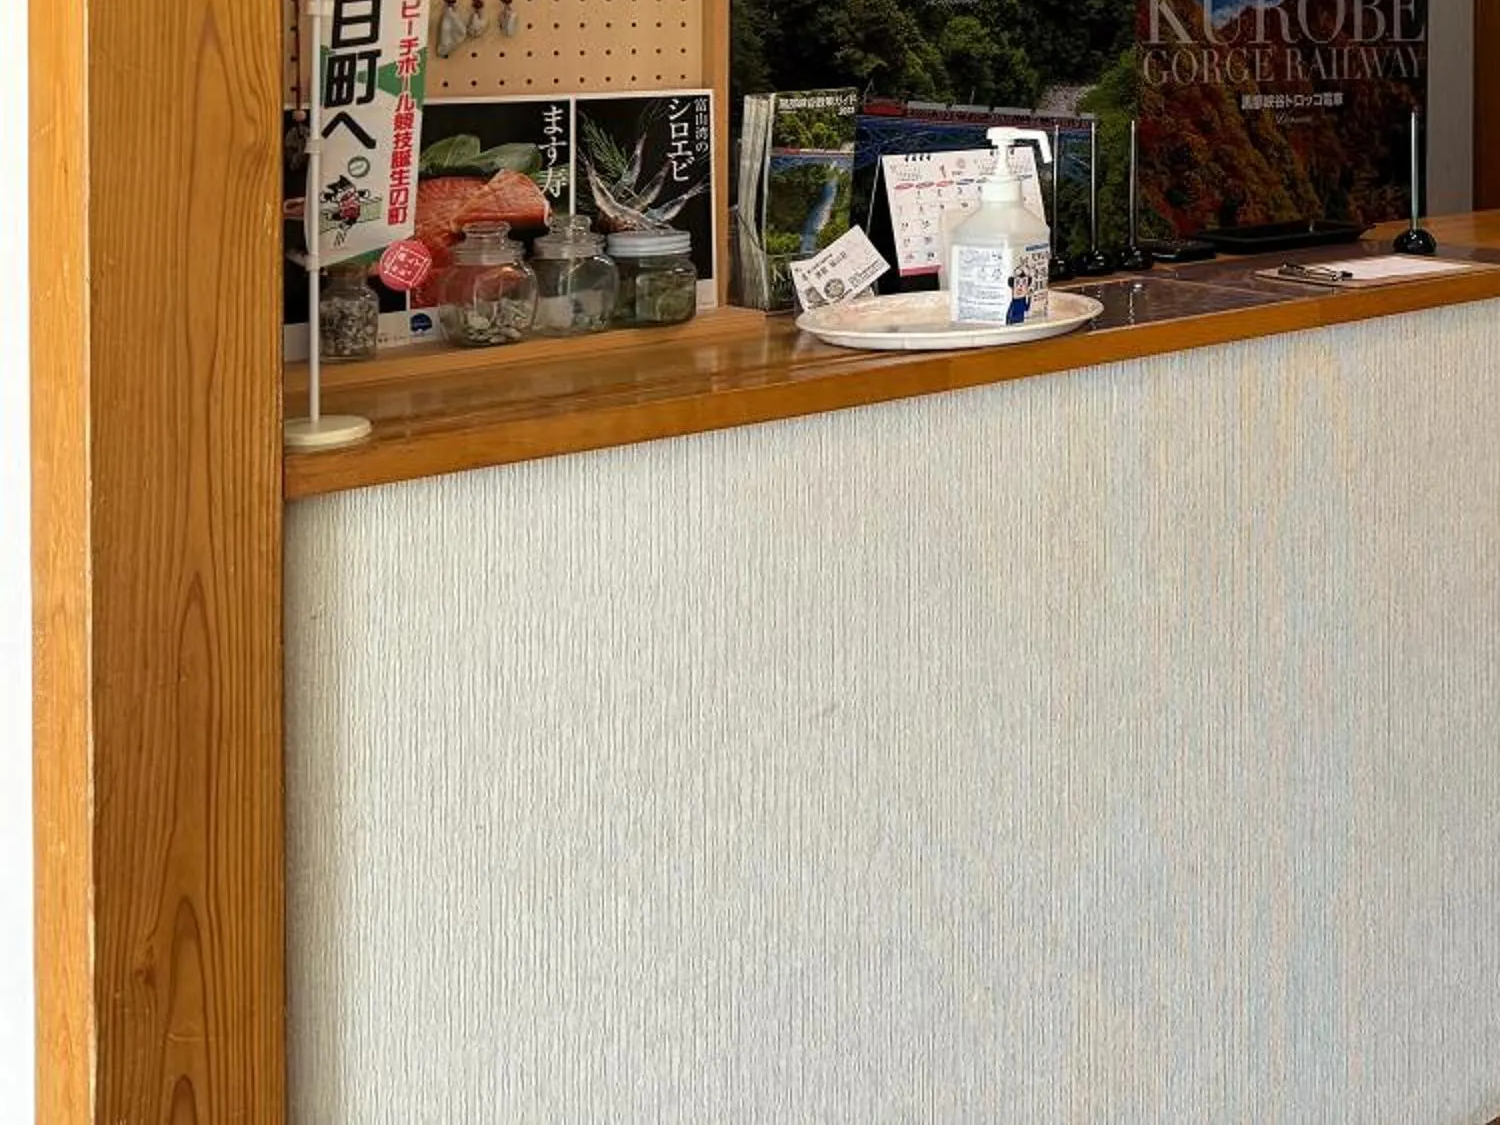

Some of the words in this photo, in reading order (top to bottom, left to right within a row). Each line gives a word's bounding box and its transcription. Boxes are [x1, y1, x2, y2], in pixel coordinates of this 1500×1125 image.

[1143, 49, 1276, 85] GORGE
[1287, 46, 1422, 82] RAILWAY
[667, 98, 695, 182] シロエビ
[694, 98, 709, 153] 富山湾の
